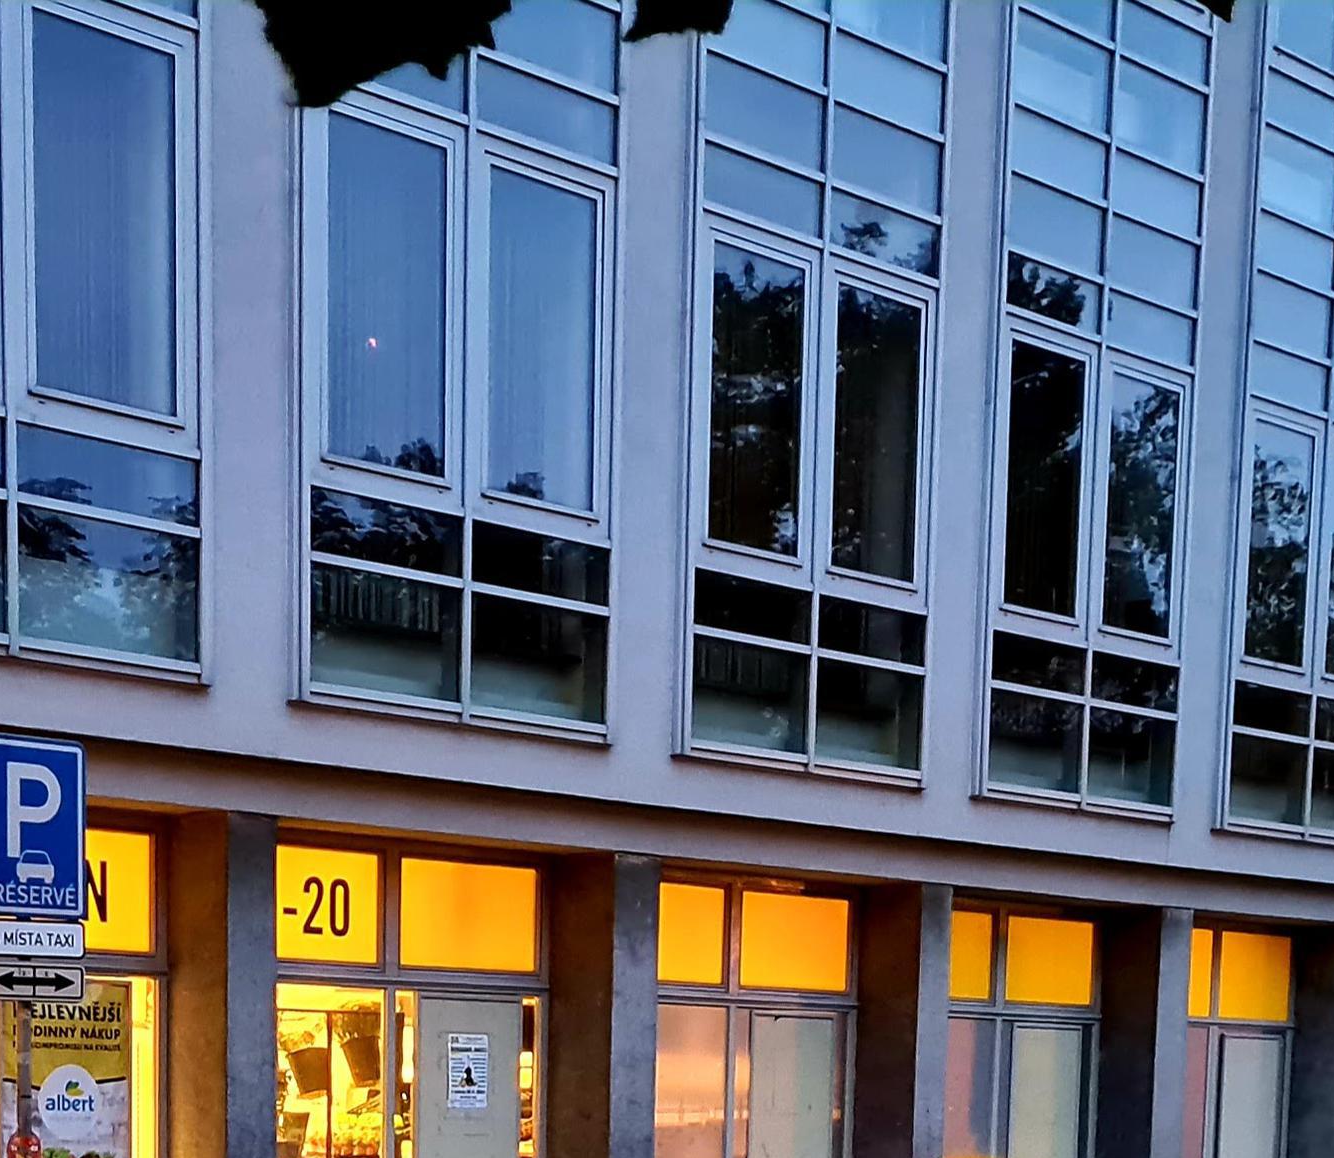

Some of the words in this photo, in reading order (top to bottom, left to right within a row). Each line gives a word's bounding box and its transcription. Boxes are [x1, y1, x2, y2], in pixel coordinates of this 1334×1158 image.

[6, 761, 62, 858] P
[3, 928, 44, 946] MÍSTA
[46, 932, 75, 948] TAXI
[13, 1001, 122, 1022] EJLEVNĚJŠÍ
[13, 1025, 76, 1038] DINNÝ
[80, 1027, 121, 1040] NÁKUP
[45, 1094, 95, 1112] albert
